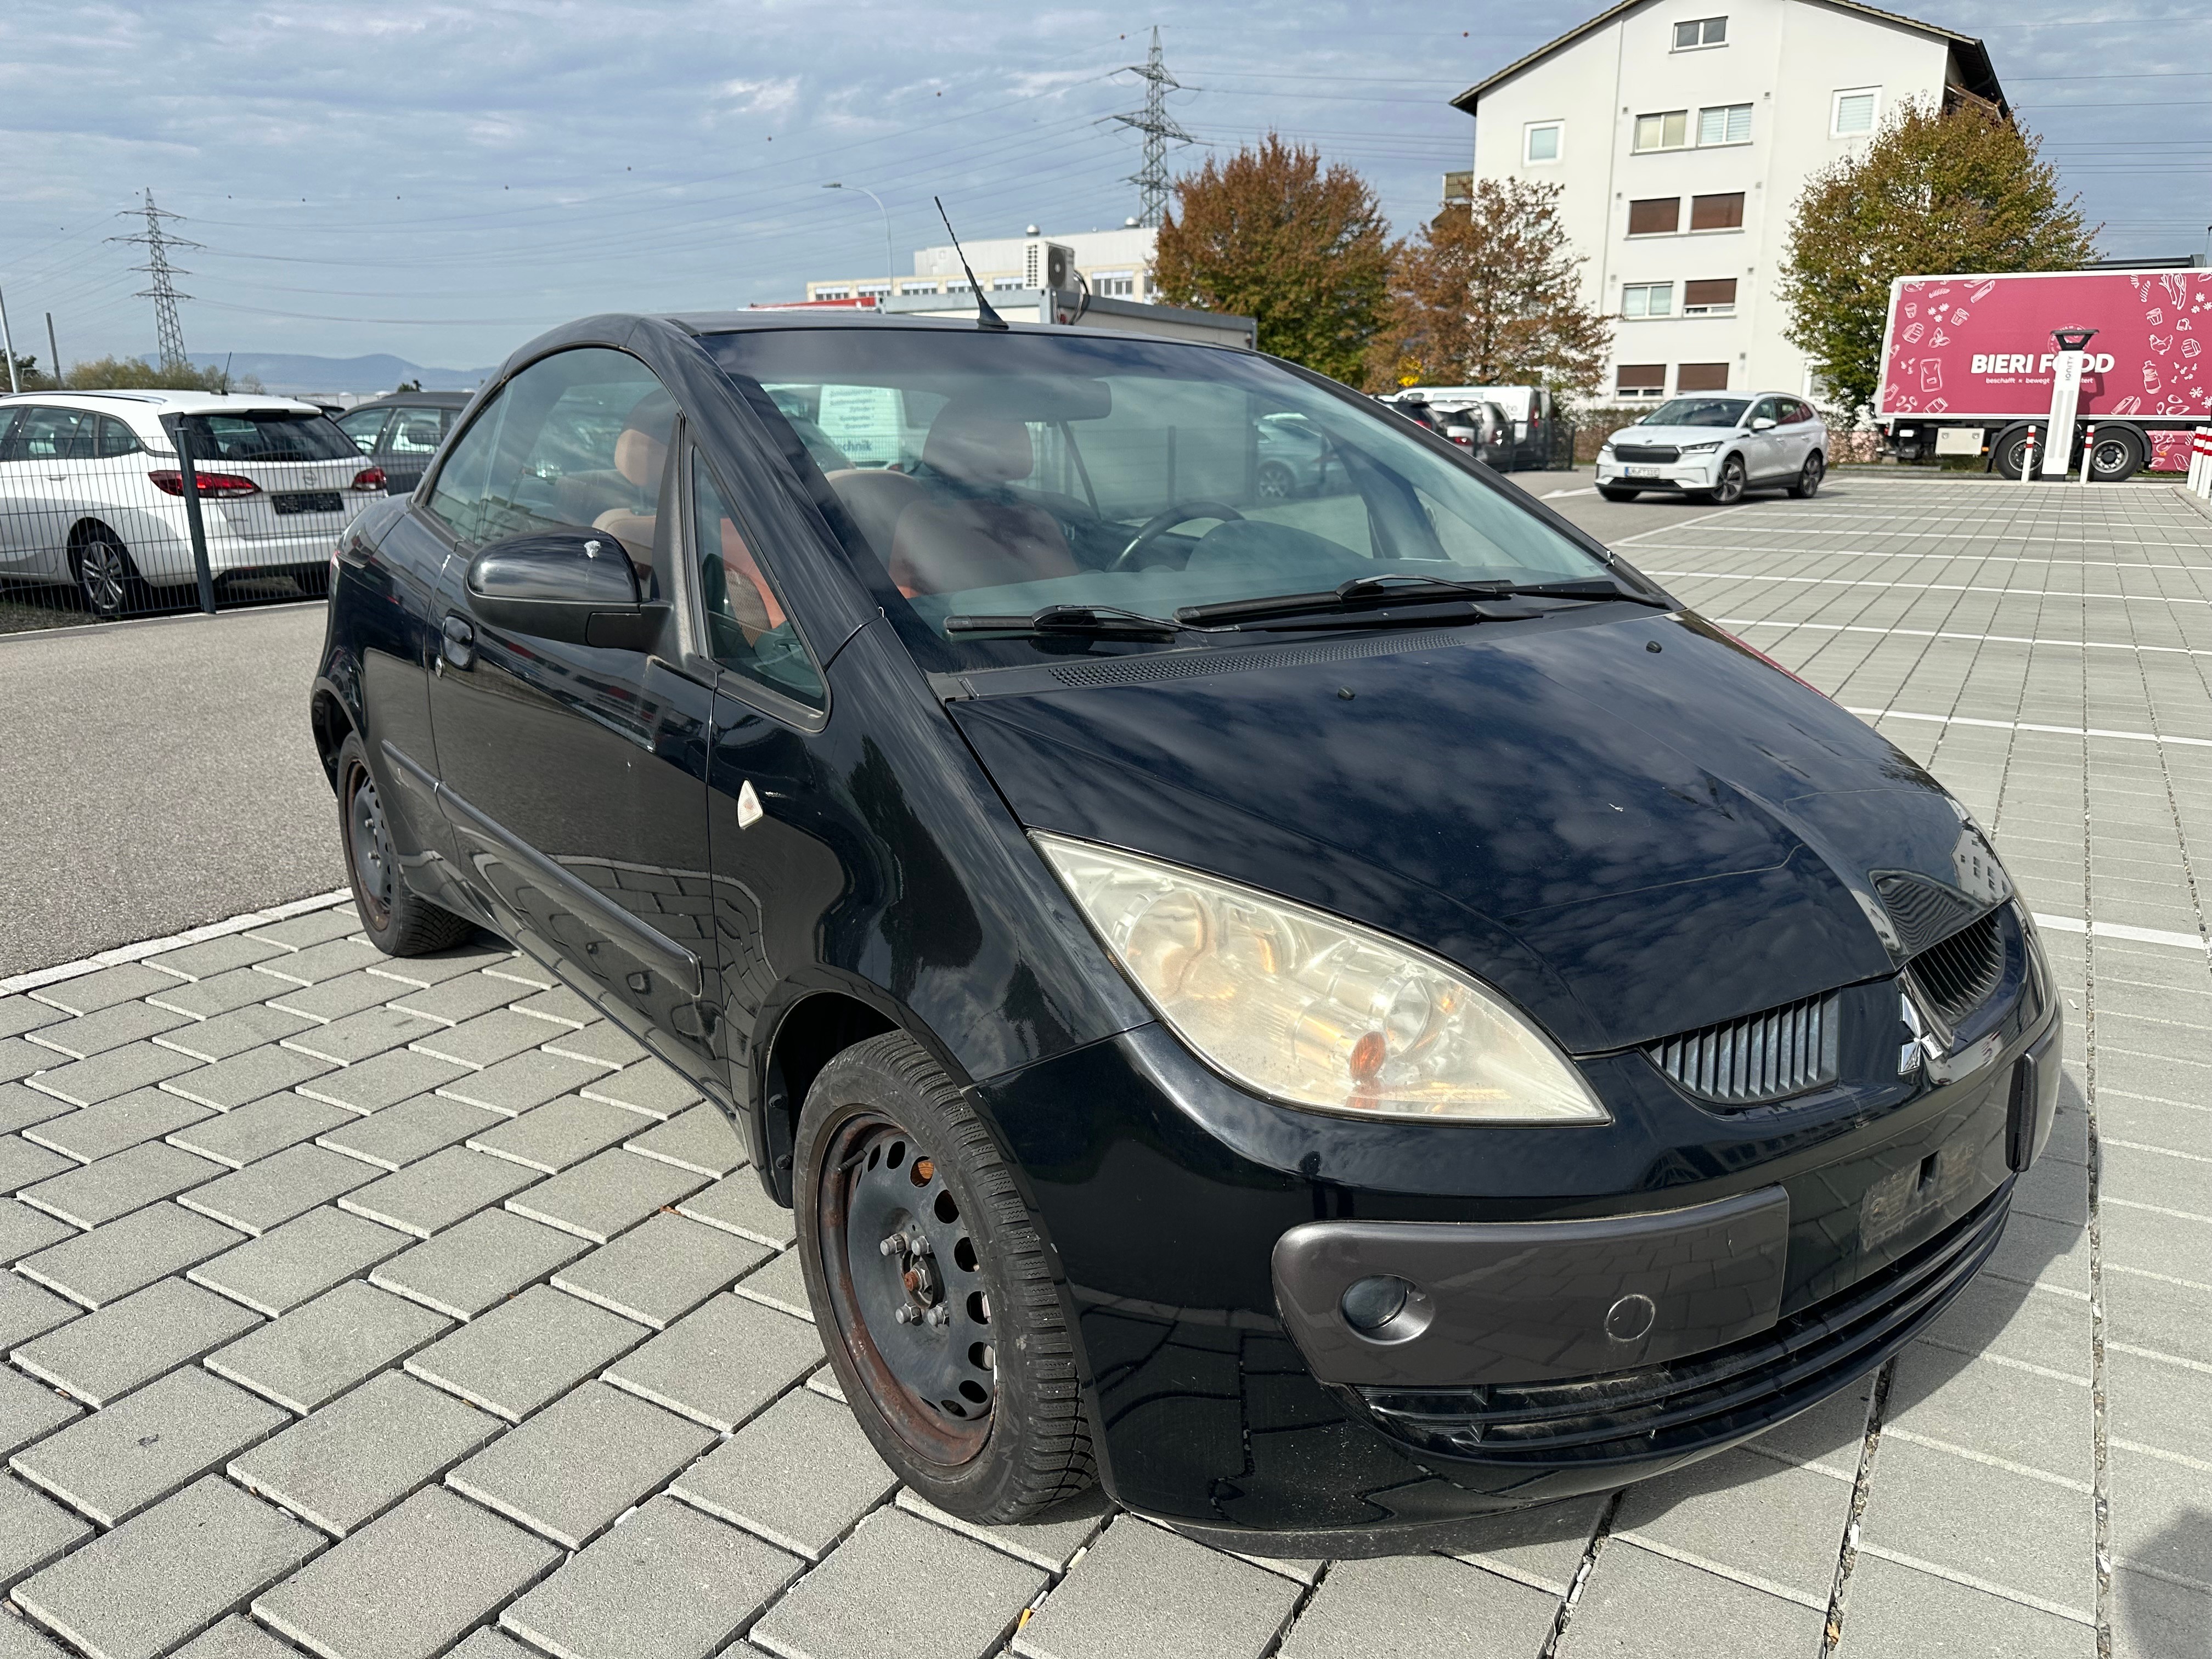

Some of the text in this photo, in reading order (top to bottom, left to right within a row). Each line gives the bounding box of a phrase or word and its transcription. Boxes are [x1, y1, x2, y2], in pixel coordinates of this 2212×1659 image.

[1971, 354, 2034, 374] BIERI
[2065, 356, 2074, 381] IONITY
[2025, 377, 2050, 385] bewegt
